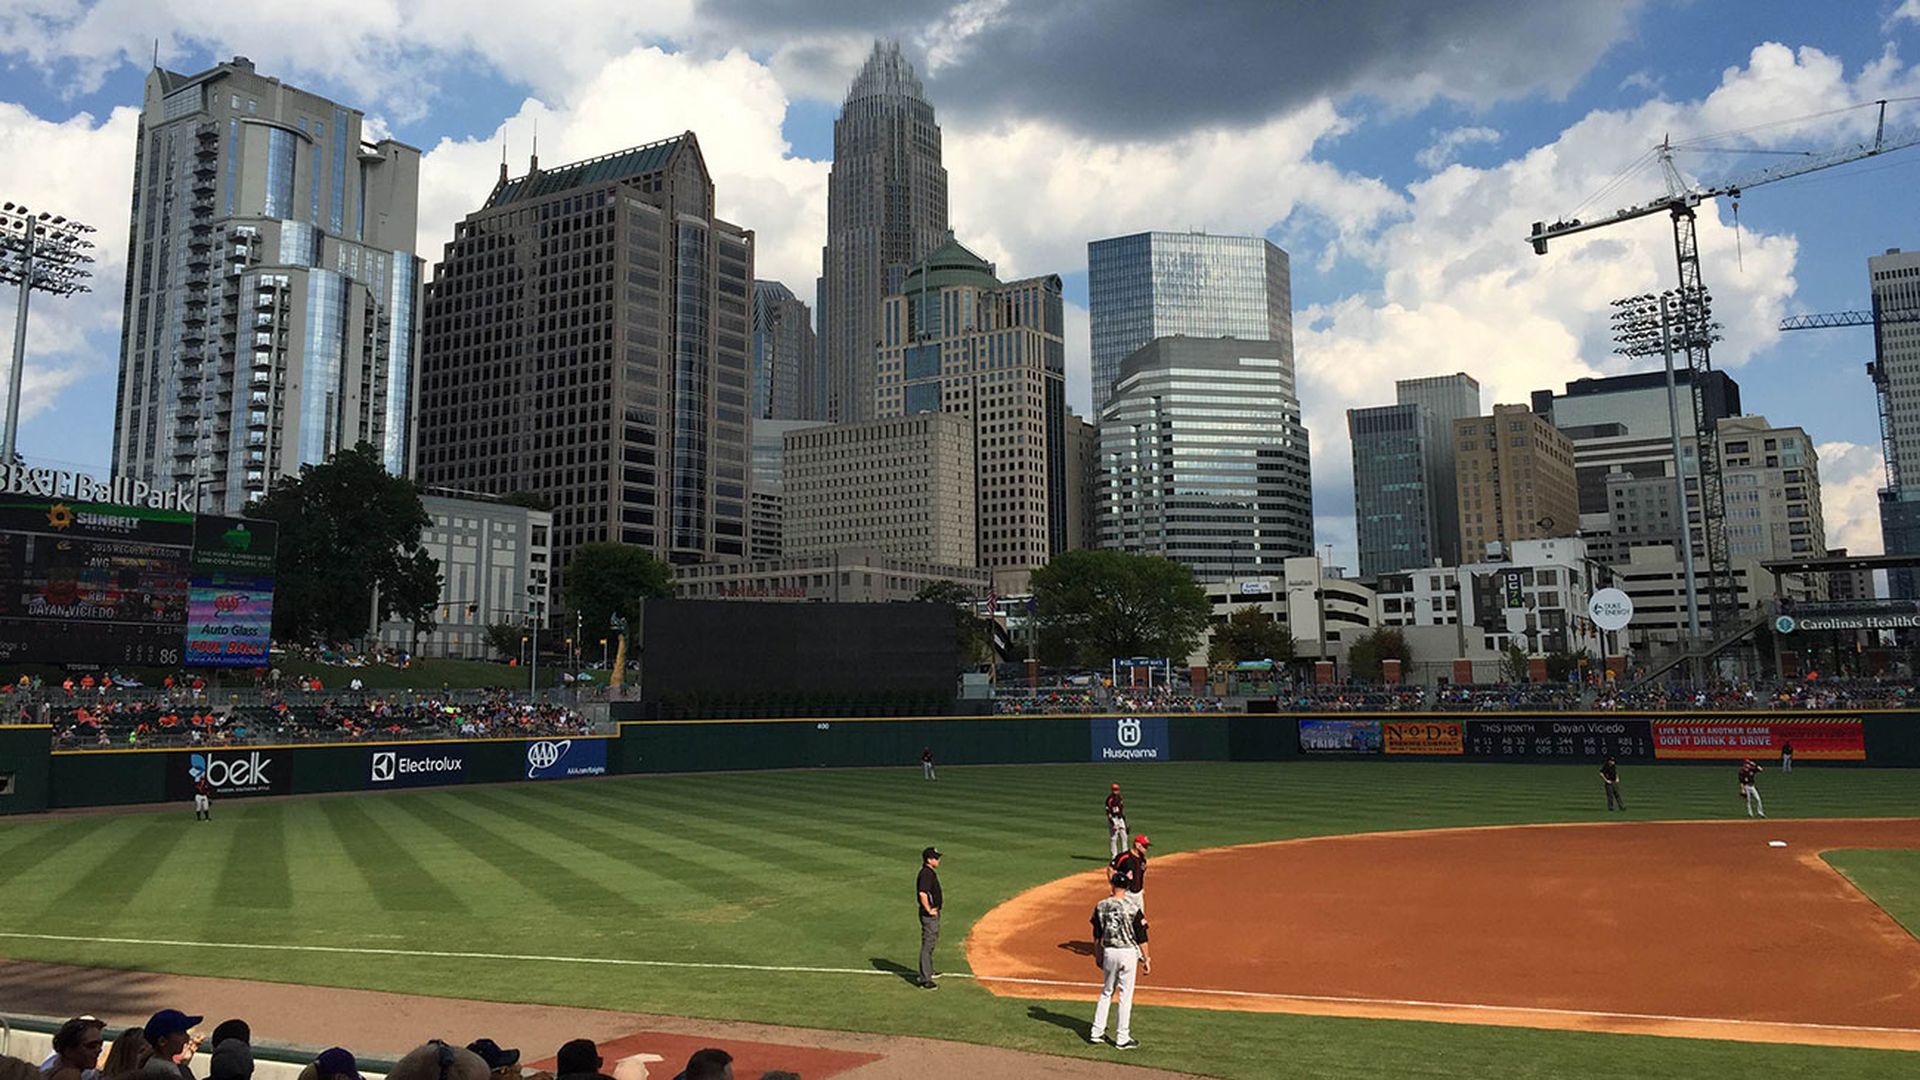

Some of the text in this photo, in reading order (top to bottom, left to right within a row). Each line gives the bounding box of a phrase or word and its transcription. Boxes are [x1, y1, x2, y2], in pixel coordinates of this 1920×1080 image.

[76, 512, 141, 528] SUNBELT
[85, 526, 130, 534] RENTALS
[89, 558, 110, 569] AVG
[143, 595, 151, 604] R
[28, 603, 115, 619] DAYAN VICIEDO
[1800, 616, 1920, 630] Carolinas HealthC
[201, 624, 259, 636] Auto Glass
[190, 640, 267, 656] FOUL BALL!
[159, 649, 178, 664] 86
[817, 722, 830, 730] 400
[1481, 724, 1626, 736] THIS MONTH Dayan Viciedo
[1659, 727, 1679, 735] LIVE
[1681, 727, 1690, 735] TO
[1692, 727, 1706, 735] SEE
[1707, 727, 1744, 735] ANOTHER
[1746, 727, 1770, 735] GAME
[1502, 737, 1513, 746] AB
[1516, 737, 1526, 746] 32
[1535, 737, 1552, 746] AVG
[1583, 737, 1596, 746] HR
[1617, 738, 1633, 746] RBI
[1660, 736, 1772, 746] DON'T DRINK & DRIVE
[531, 741, 555, 767] AAA
[1102, 747, 1158, 760] Husqvarna
[1502, 746, 1513, 755] SB
[1535, 746, 1552, 755] OPS
[1584, 746, 1596, 755] BB
[1602, 746, 1607, 755] 0
[1619, 746, 1633, 755] SO
[207, 751, 273, 786] belk
[399, 755, 463, 774] Electrolux
